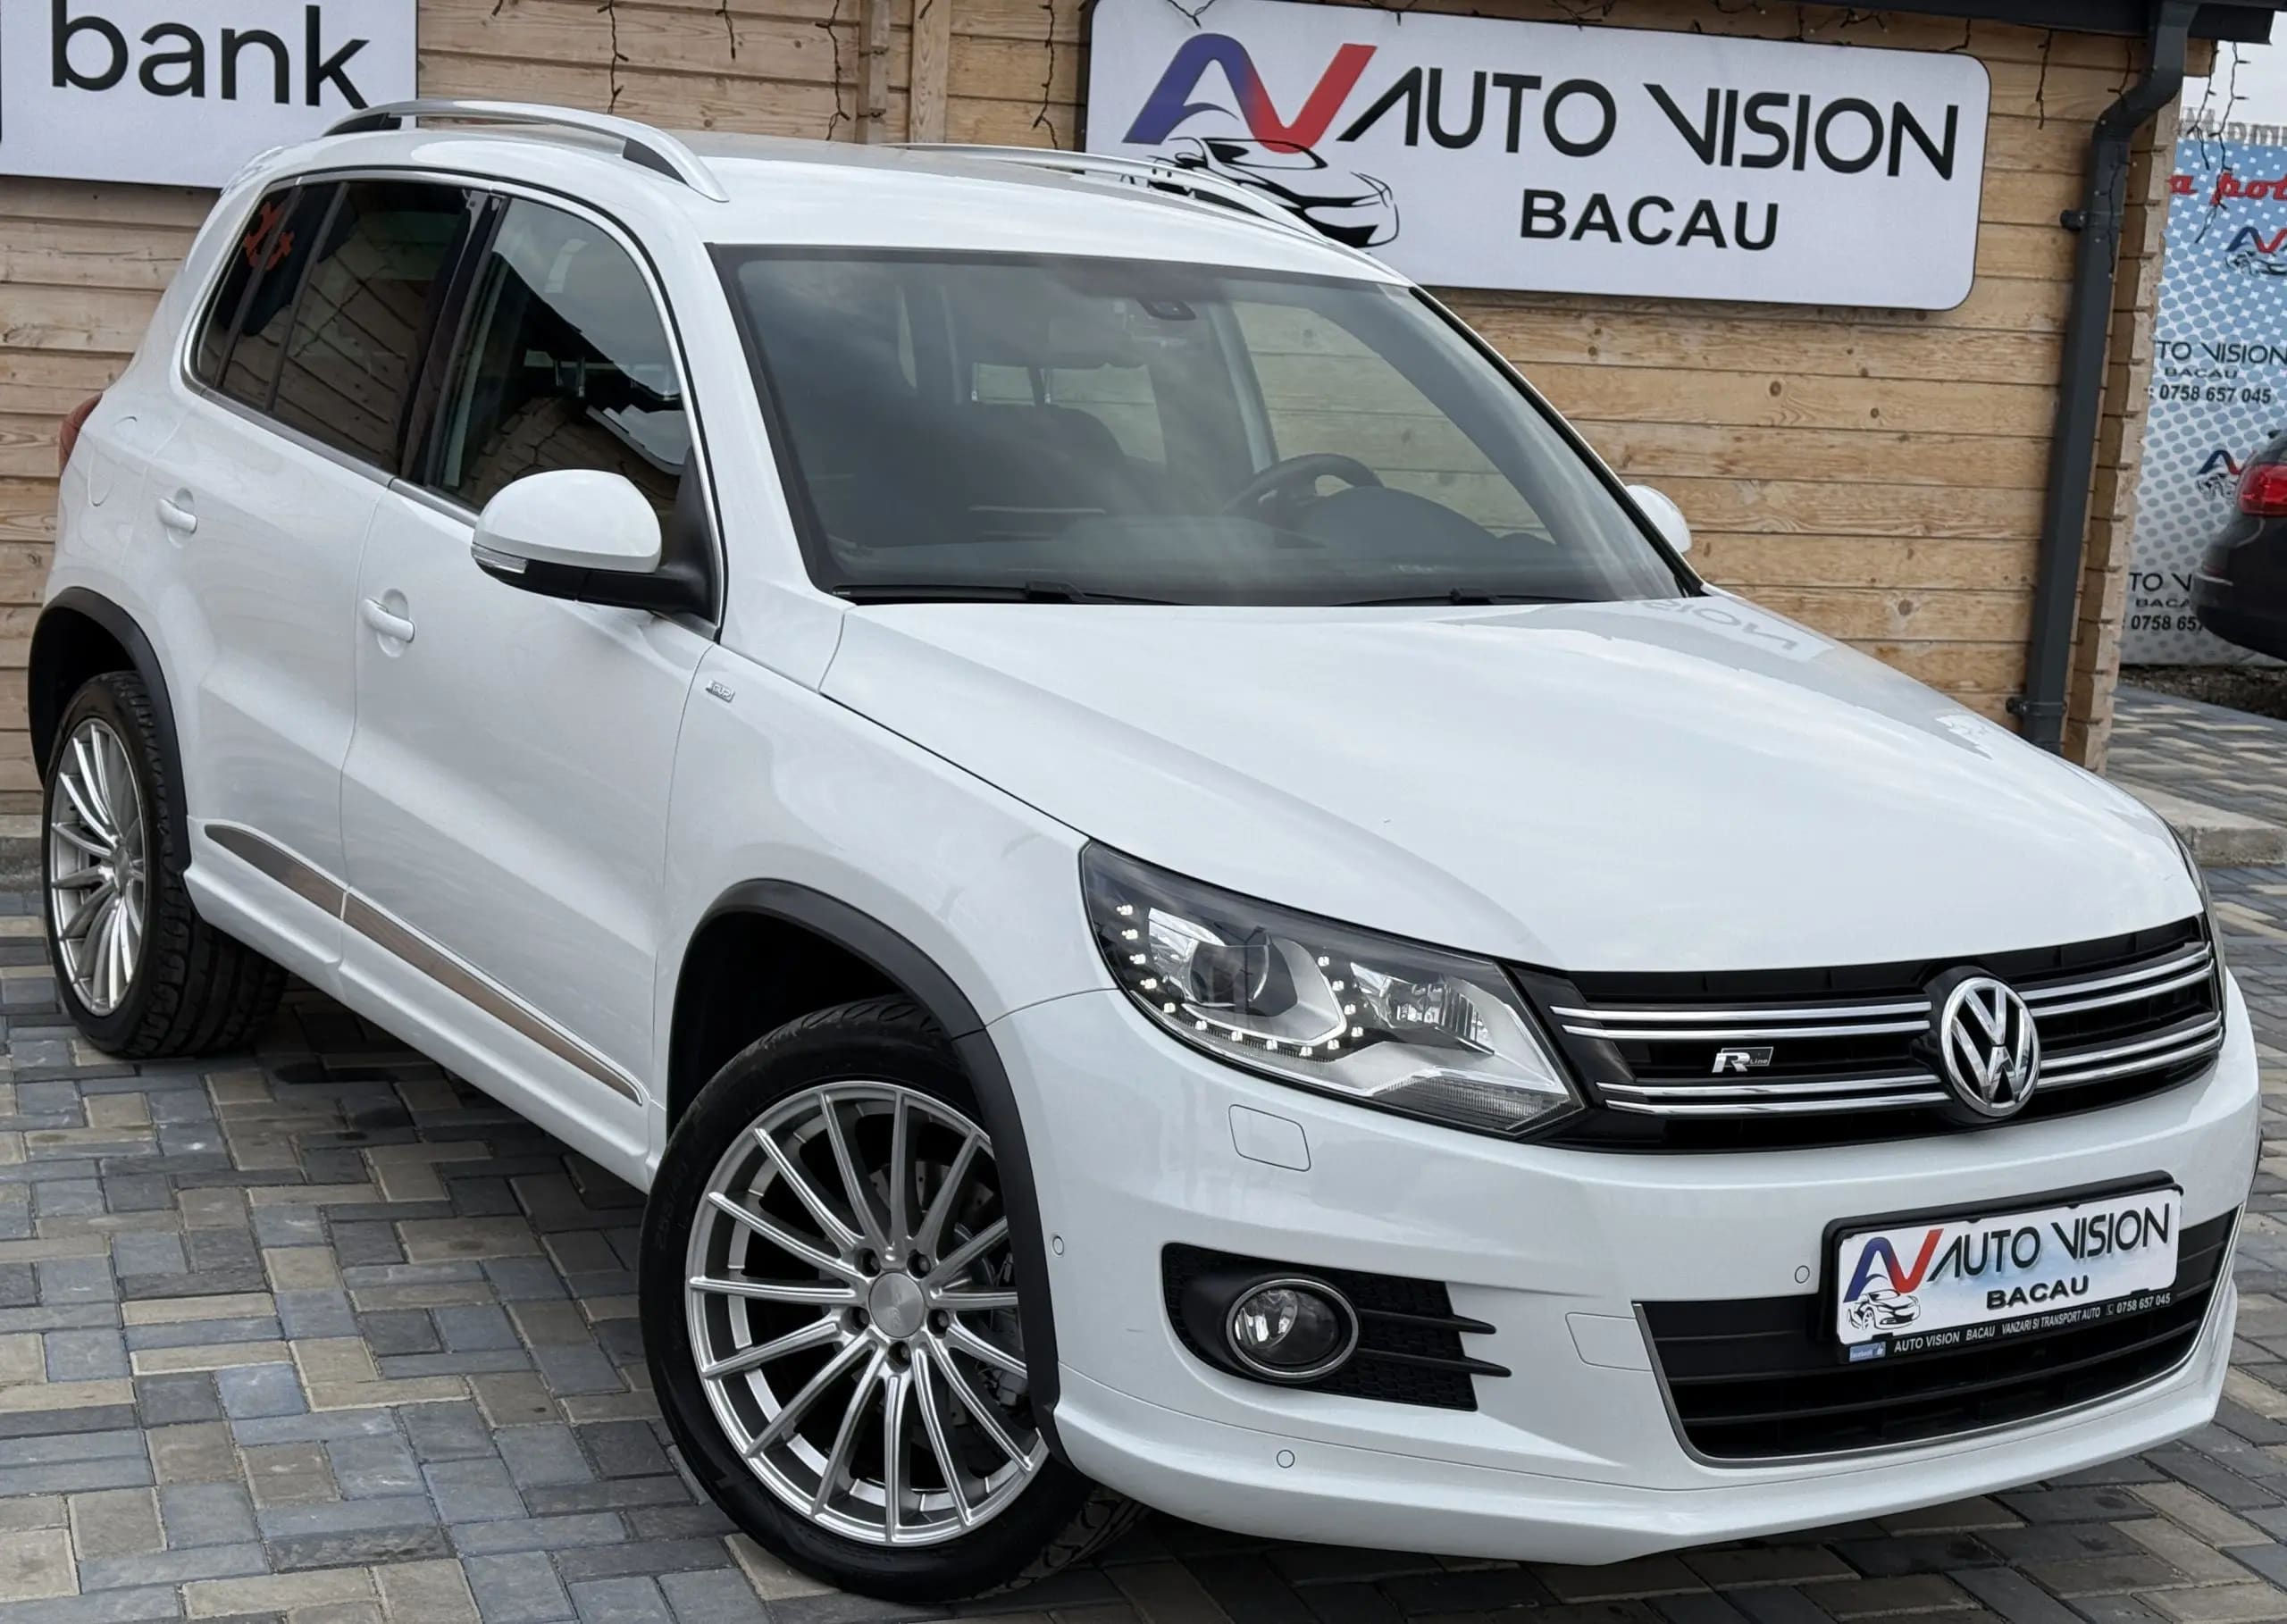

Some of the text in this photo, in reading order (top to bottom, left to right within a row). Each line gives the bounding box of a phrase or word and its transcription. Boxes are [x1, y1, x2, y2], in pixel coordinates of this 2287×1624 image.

[52, 0, 370, 109] bank
[1336, 66, 1958, 180] AUTO VISION
[1520, 188, 1778, 251] BACAU
[2157, 340, 2287, 366] TO VISION
[2164, 367, 2238, 380] BACAU
[2159, 384, 2272, 403] 0758 657 045
[2136, 599, 2190, 608] BACA
[2131, 615, 2202, 632] 0758 65
[1927, 1203, 2170, 1282] AUTO VISION
[1986, 1275, 2090, 1310] BACAU
[1894, 1338, 1923, 1352] AUTO
[1926, 1332, 1960, 1347] VISION
[1965, 1326, 1996, 1341] BACAU
[2002, 1320, 2031, 1335] VANZARI
[2040, 1310, 2082, 1327] TRANSPORT
[2082, 1307, 2100, 1321] AUTO
[2116, 1301, 2138, 1314] 0758
[2139, 1297, 2154, 1310] 657
[2155, 1293, 2171, 1307] 045
